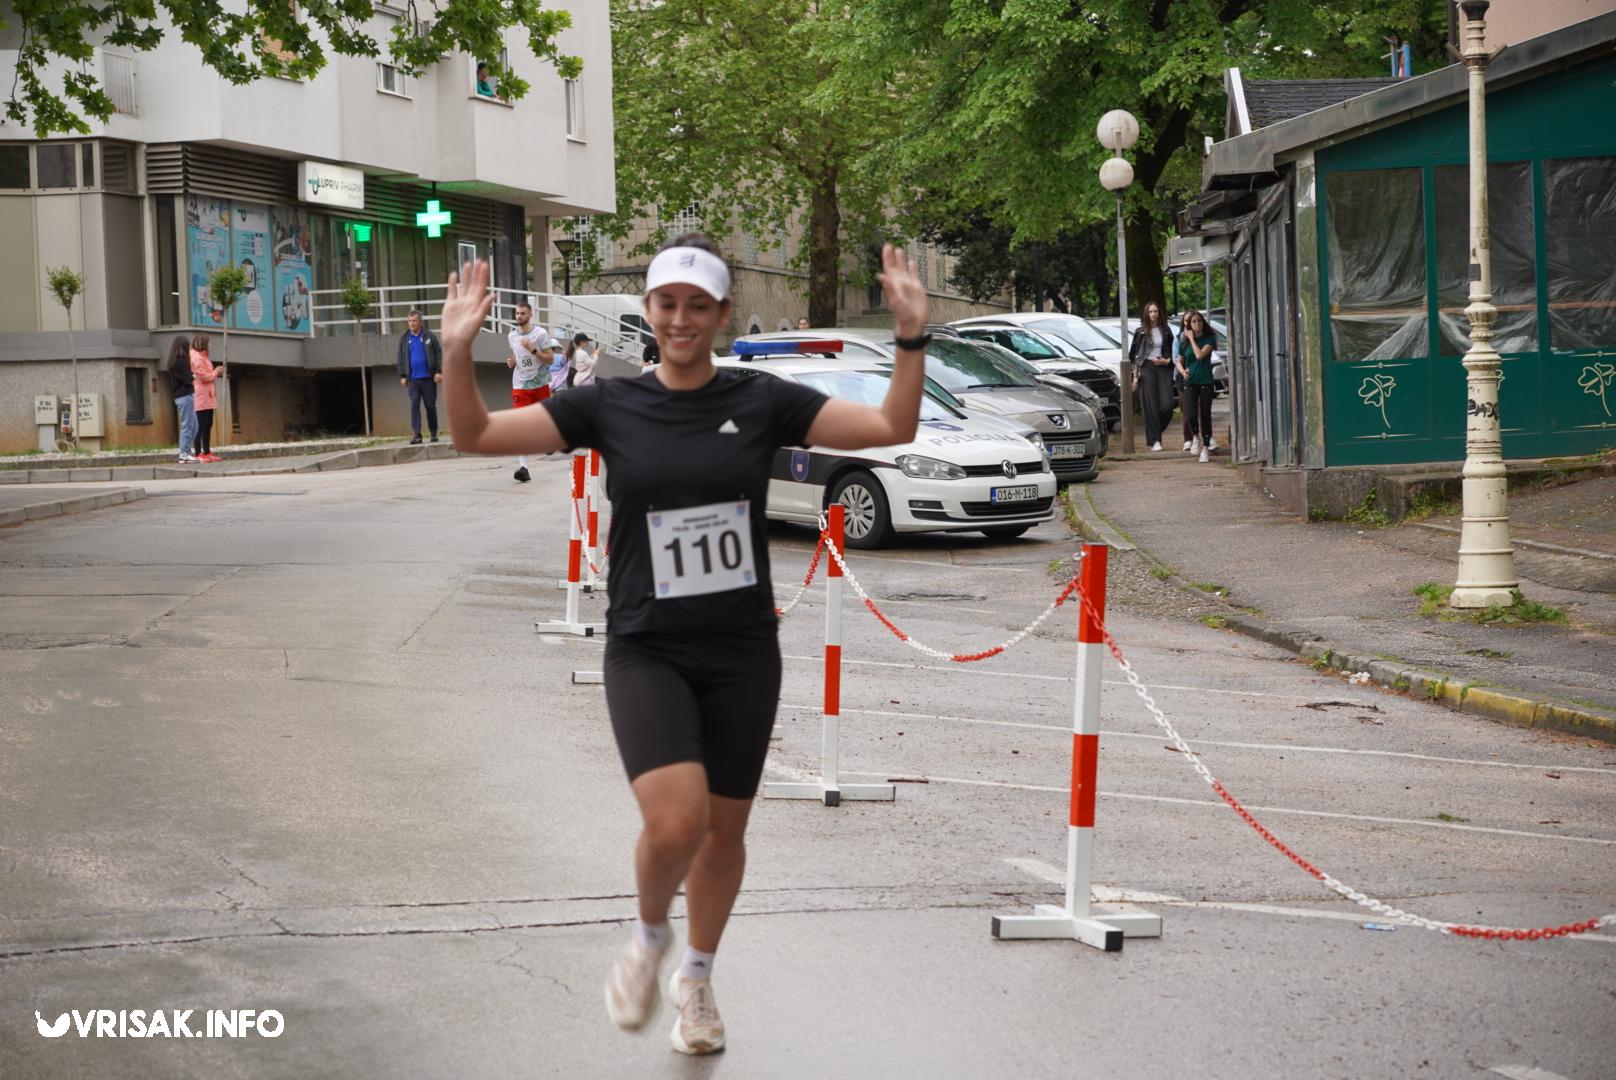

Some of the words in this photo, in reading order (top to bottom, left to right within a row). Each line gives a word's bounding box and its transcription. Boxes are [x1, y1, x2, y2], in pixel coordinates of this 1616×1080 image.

[317, 177, 339, 190] LUPRIV
[521, 358, 533, 367] 58
[929, 433, 1022, 446] POLICIJA
[997, 486, 1037, 501] 016-M-118
[664, 530, 742, 577] 110
